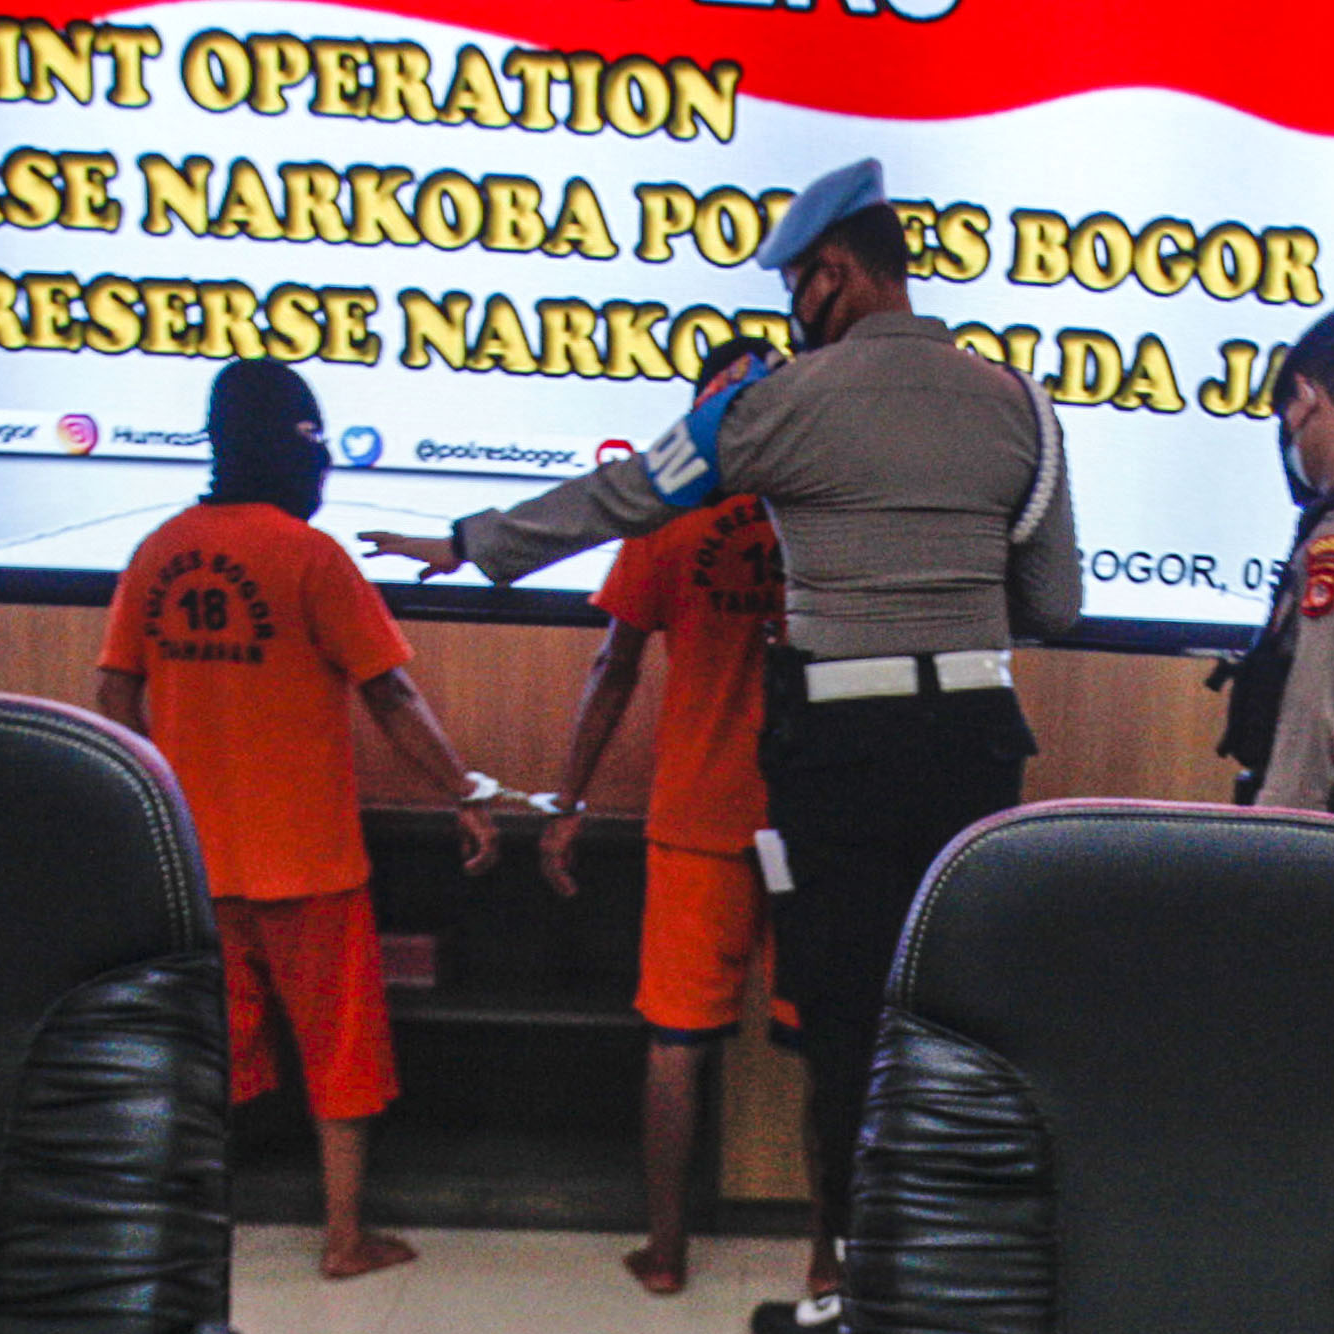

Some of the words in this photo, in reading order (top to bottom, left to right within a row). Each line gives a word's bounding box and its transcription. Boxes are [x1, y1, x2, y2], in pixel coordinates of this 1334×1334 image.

[180, 27, 743, 145] OPERATION
[137, 152, 619, 260] NARKOBA
[1008, 206, 1324, 306] BOGOR
[179, 587, 228, 632] 18
[1080, 548, 1227, 594] OGOR,
